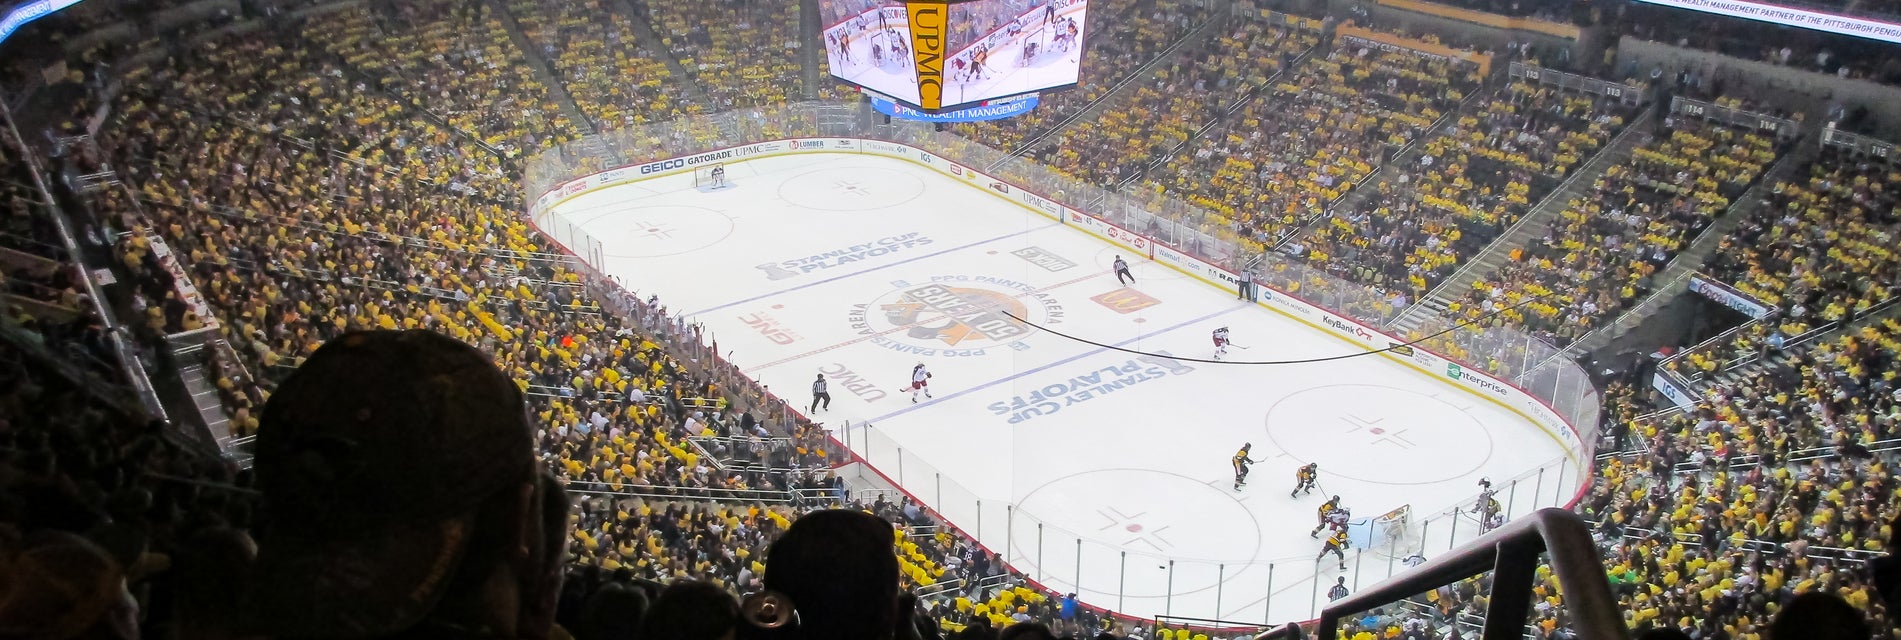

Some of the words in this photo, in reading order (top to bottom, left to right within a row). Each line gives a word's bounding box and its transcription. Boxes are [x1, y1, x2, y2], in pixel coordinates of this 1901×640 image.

[1710, 1, 1759, 15] MANAGEMENT
[1760, 8, 1794, 20] PARTNER
[1807, 16, 1822, 24] THE
[1823, 19, 1873, 32] PITTSBURGH
[915, 7, 940, 101] UPMC
[1607, 87, 1620, 97] 113
[902, 106, 919, 117] PNC
[968, 100, 1027, 118] MANAGEMENT
[735, 144, 764, 157] UPMC
[799, 140, 824, 148] LUMBER
[640, 158, 684, 175] GEICO
[687, 150, 733, 165] GATORADE
[920, 152, 931, 163] IGS
[1023, 192, 1045, 209] UPMC
[781, 241, 873, 269] STANLEY
[876, 231, 919, 245] CUP
[799, 236, 933, 273] PLAYOFFS
[1158, 248, 1180, 263] Walmart
[930, 274, 969, 283] PPG
[974, 275, 1036, 292] PAINTS
[1035, 292, 1065, 324] ARENA
[738, 313, 794, 345] GNC
[849, 303, 874, 335] ARENA
[1322, 315, 1355, 335] KeyBank
[870, 337, 936, 357] PAINTS
[943, 348, 986, 358] PPG
[819, 362, 887, 403] UPMC
[986, 360, 1143, 415] PLAYOFFS
[1065, 366, 1167, 407] STANLEY
[1662, 381, 1676, 399] IGS
[1007, 401, 1061, 424] CUP
